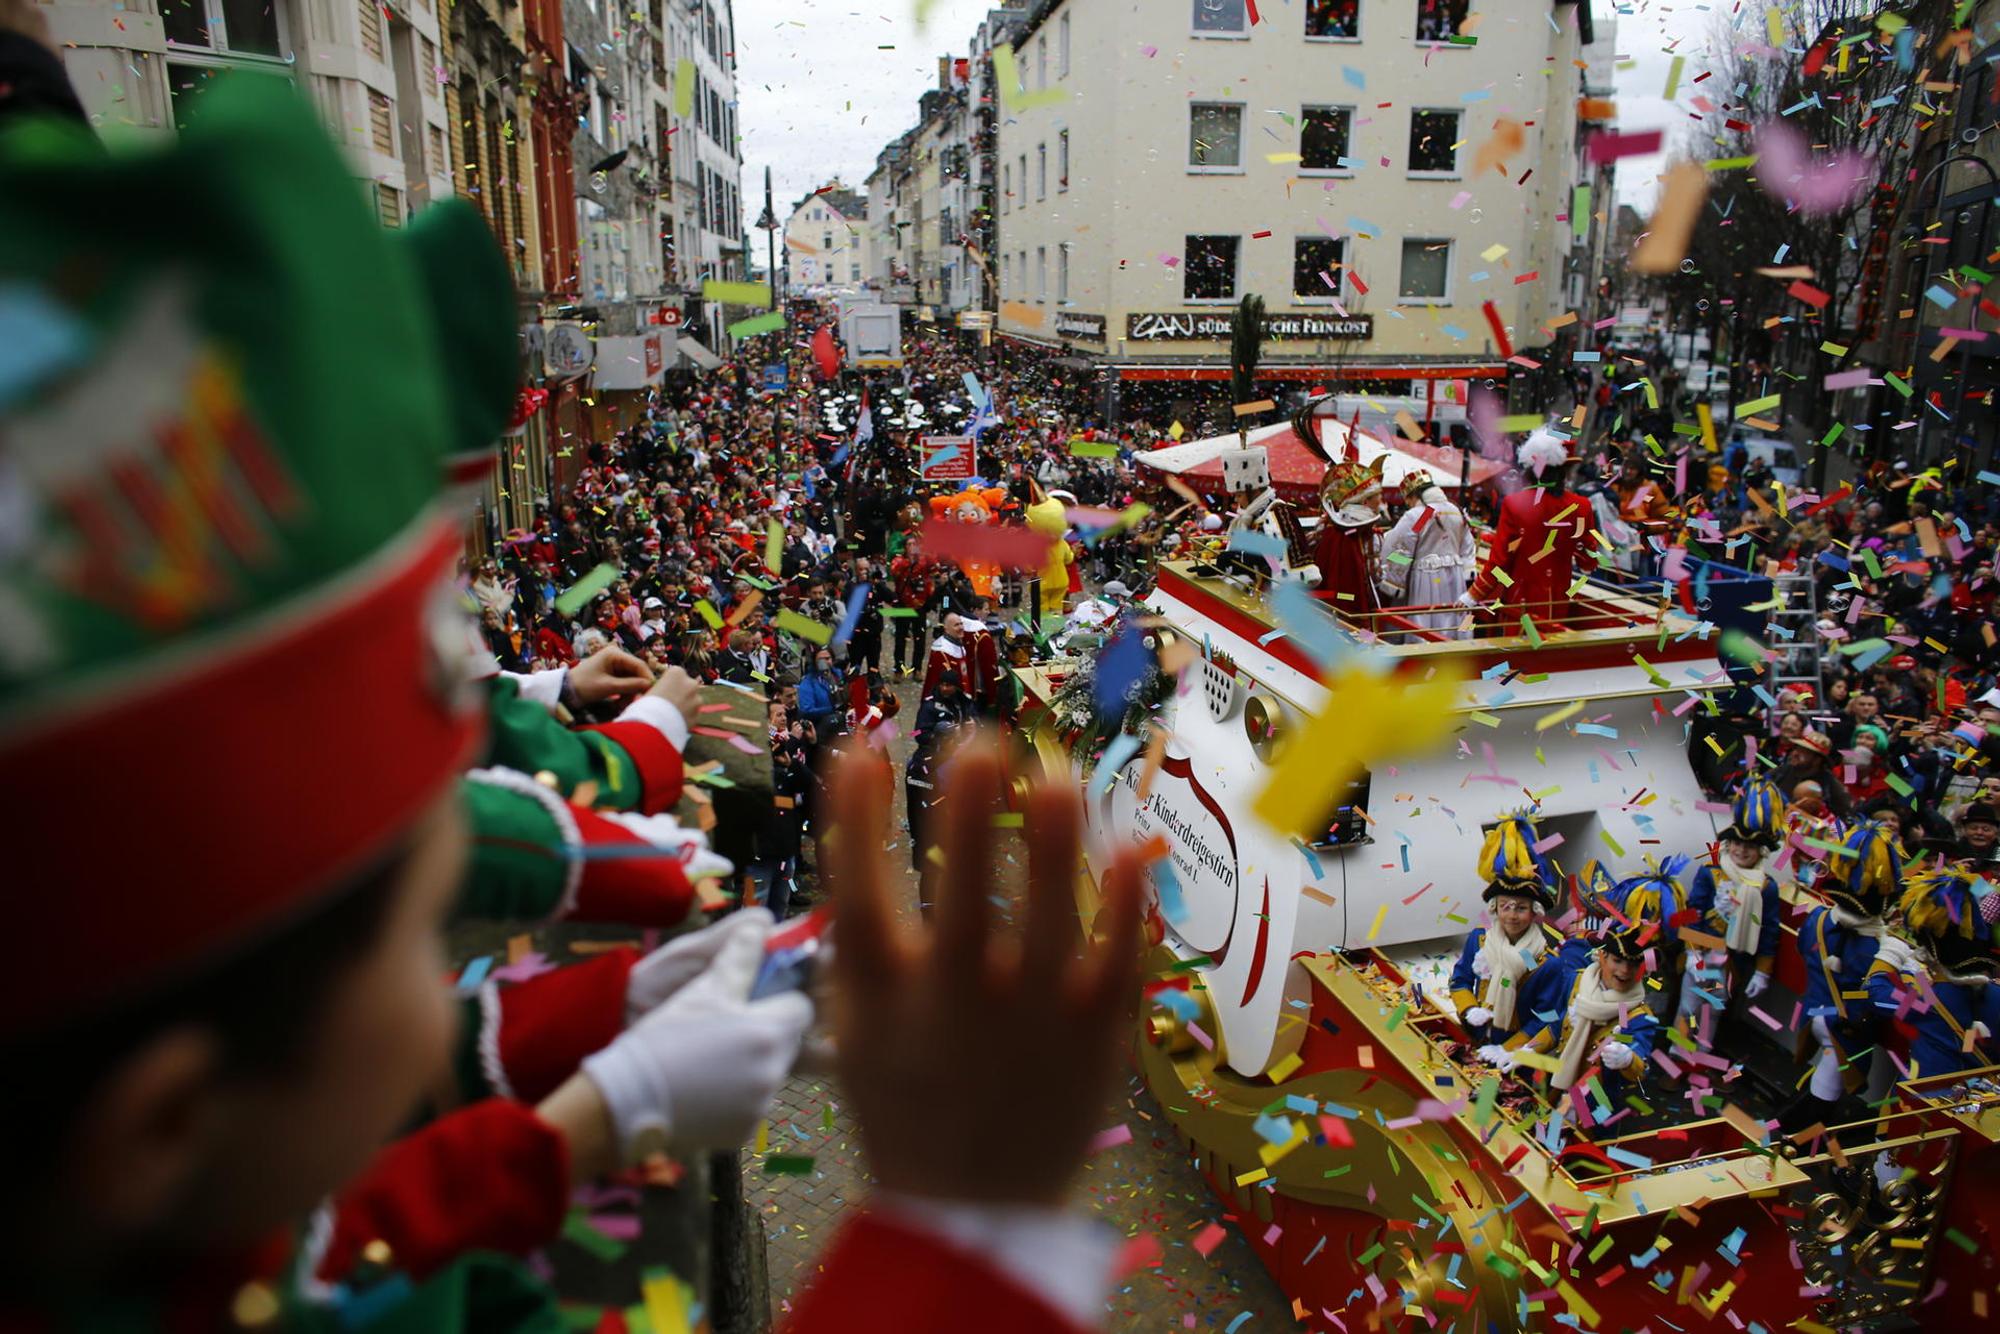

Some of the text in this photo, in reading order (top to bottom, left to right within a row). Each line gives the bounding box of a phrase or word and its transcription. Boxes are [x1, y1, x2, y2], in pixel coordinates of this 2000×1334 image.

[1133, 313, 1193, 338] CAN
[1303, 319, 1368, 334] FEINKOST
[1126, 767, 1233, 888] Kör Kinderdreigestirn
